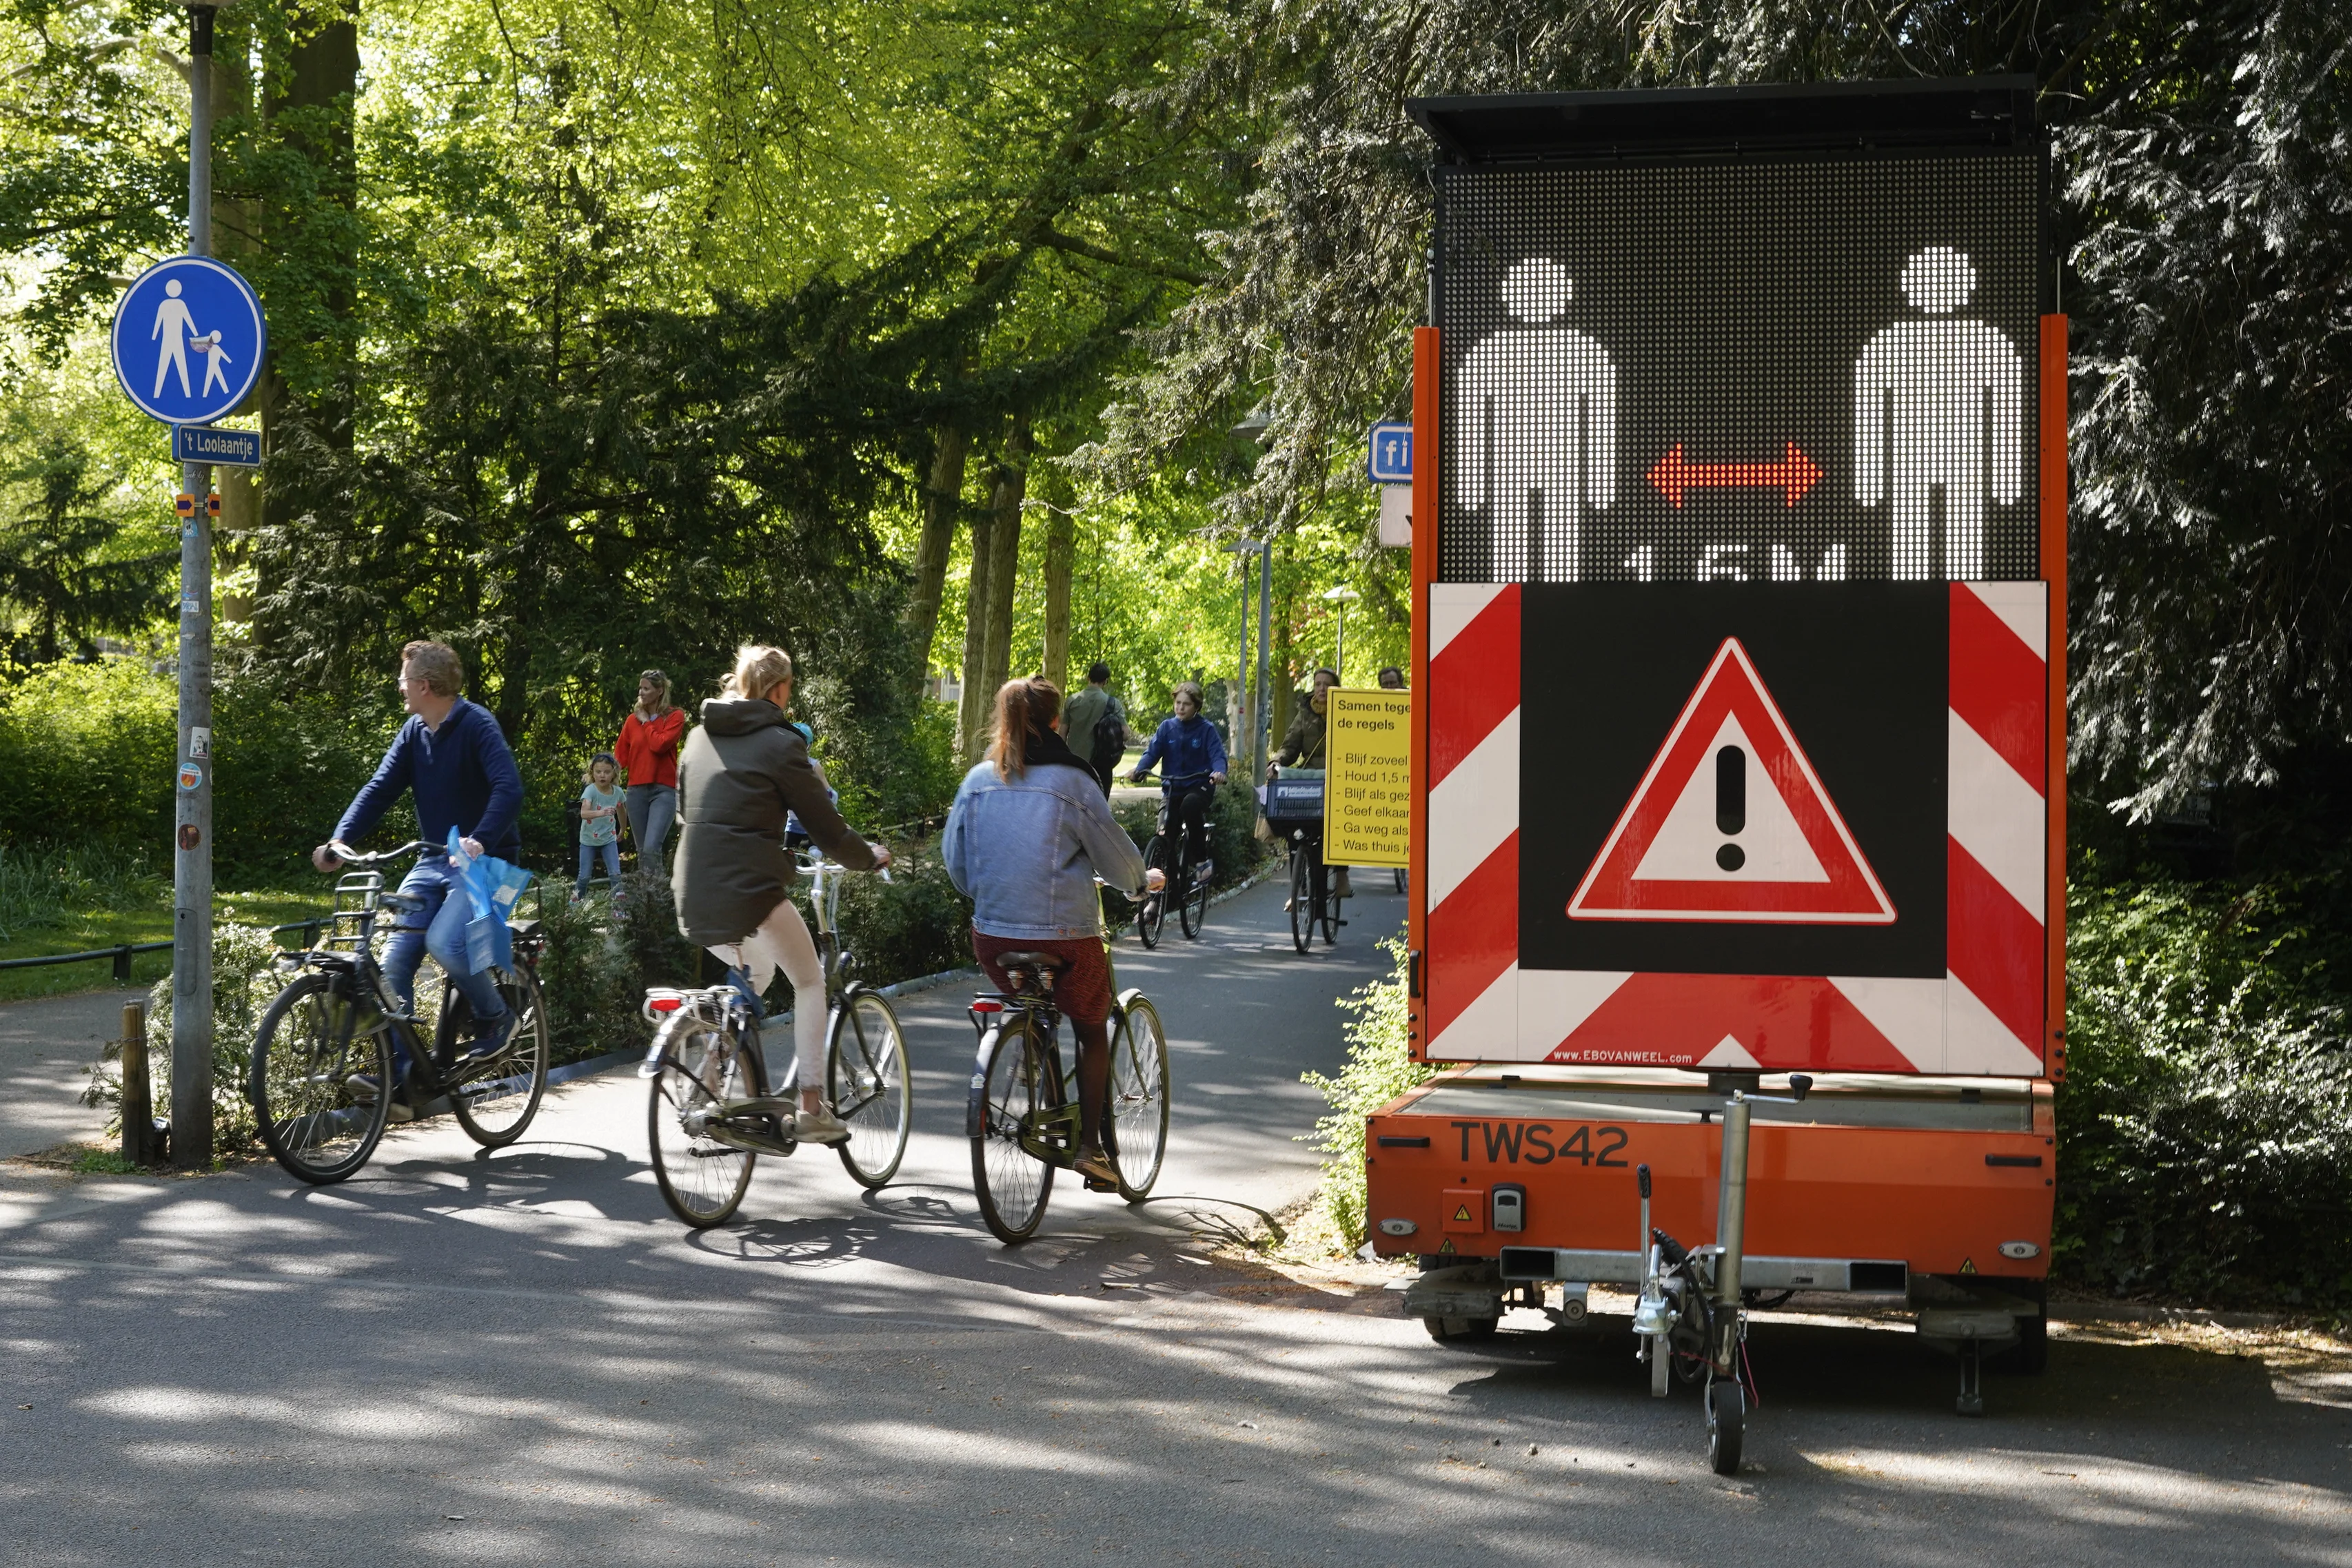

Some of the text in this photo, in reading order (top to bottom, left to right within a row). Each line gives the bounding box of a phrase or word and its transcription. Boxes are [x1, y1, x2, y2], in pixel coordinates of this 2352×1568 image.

[185, 432, 253, 461] 't Loolaantje
[1386, 440, 1408, 467] fi
[1338, 700, 1410, 715] Samen tege
[1337, 717, 1395, 732] de regels
[1346, 753, 1408, 766] Blijf zoveel
[1345, 770, 1377, 782] Houd
[1381, 771, 1399, 784] 1,5
[1345, 787, 1410, 803] Blijf als gez
[1344, 804, 1410, 818] Geef elkaar
[1344, 822, 1408, 837] Ga weg als
[1343, 839, 1368, 851] Was
[1372, 841, 1400, 853] thuis
[1553, 1050, 1692, 1063] www.EBOVANWEEL.com
[1450, 1121, 1629, 1168] TWS42
